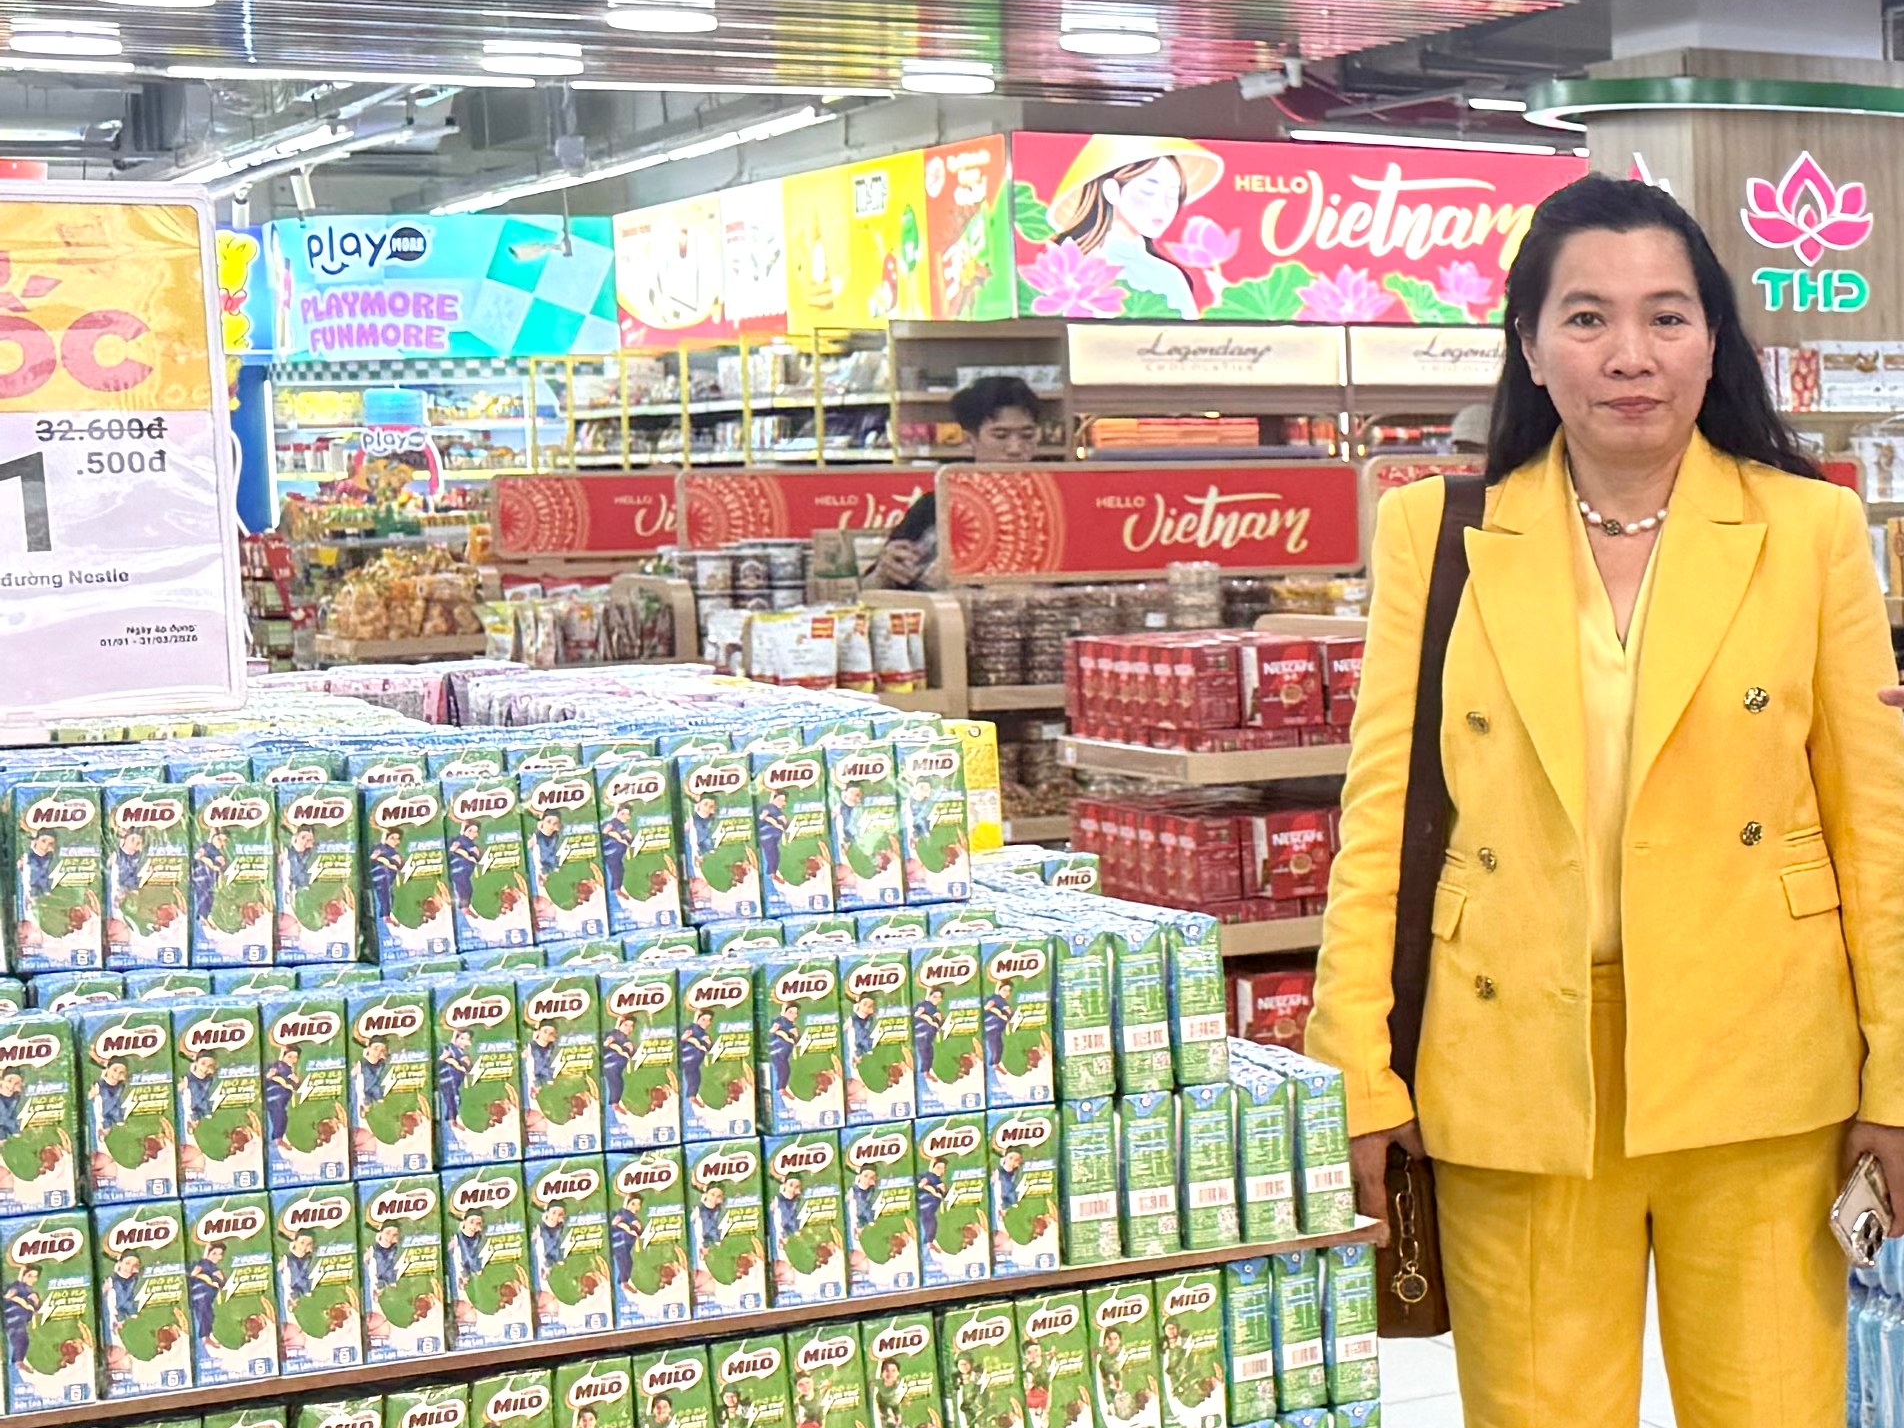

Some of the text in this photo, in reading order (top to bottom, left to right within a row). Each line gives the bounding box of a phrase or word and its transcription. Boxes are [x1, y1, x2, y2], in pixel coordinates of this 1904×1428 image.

[1235, 162, 1536, 272] HELLO Vietnam
[307, 226, 386, 271] play
[1752, 268, 1870, 313] THD
[301, 290, 458, 322] PLAYMORE
[310, 323, 445, 352] FUNMORE
[36, 416, 168, 442] 32.600đ
[1096, 484, 1310, 553] HELLO Vietnam
[33, 809, 83, 822] MILO
[383, 806, 430, 820] MILO
[535, 1000, 582, 1013] MILO
[192, 1025, 244, 1044] MILO
[857, 1144, 900, 1158] MILO
[204, 1217, 256, 1234] MILO
[962, 1322, 1004, 1344] MILO
[728, 1358, 773, 1374] MILO
